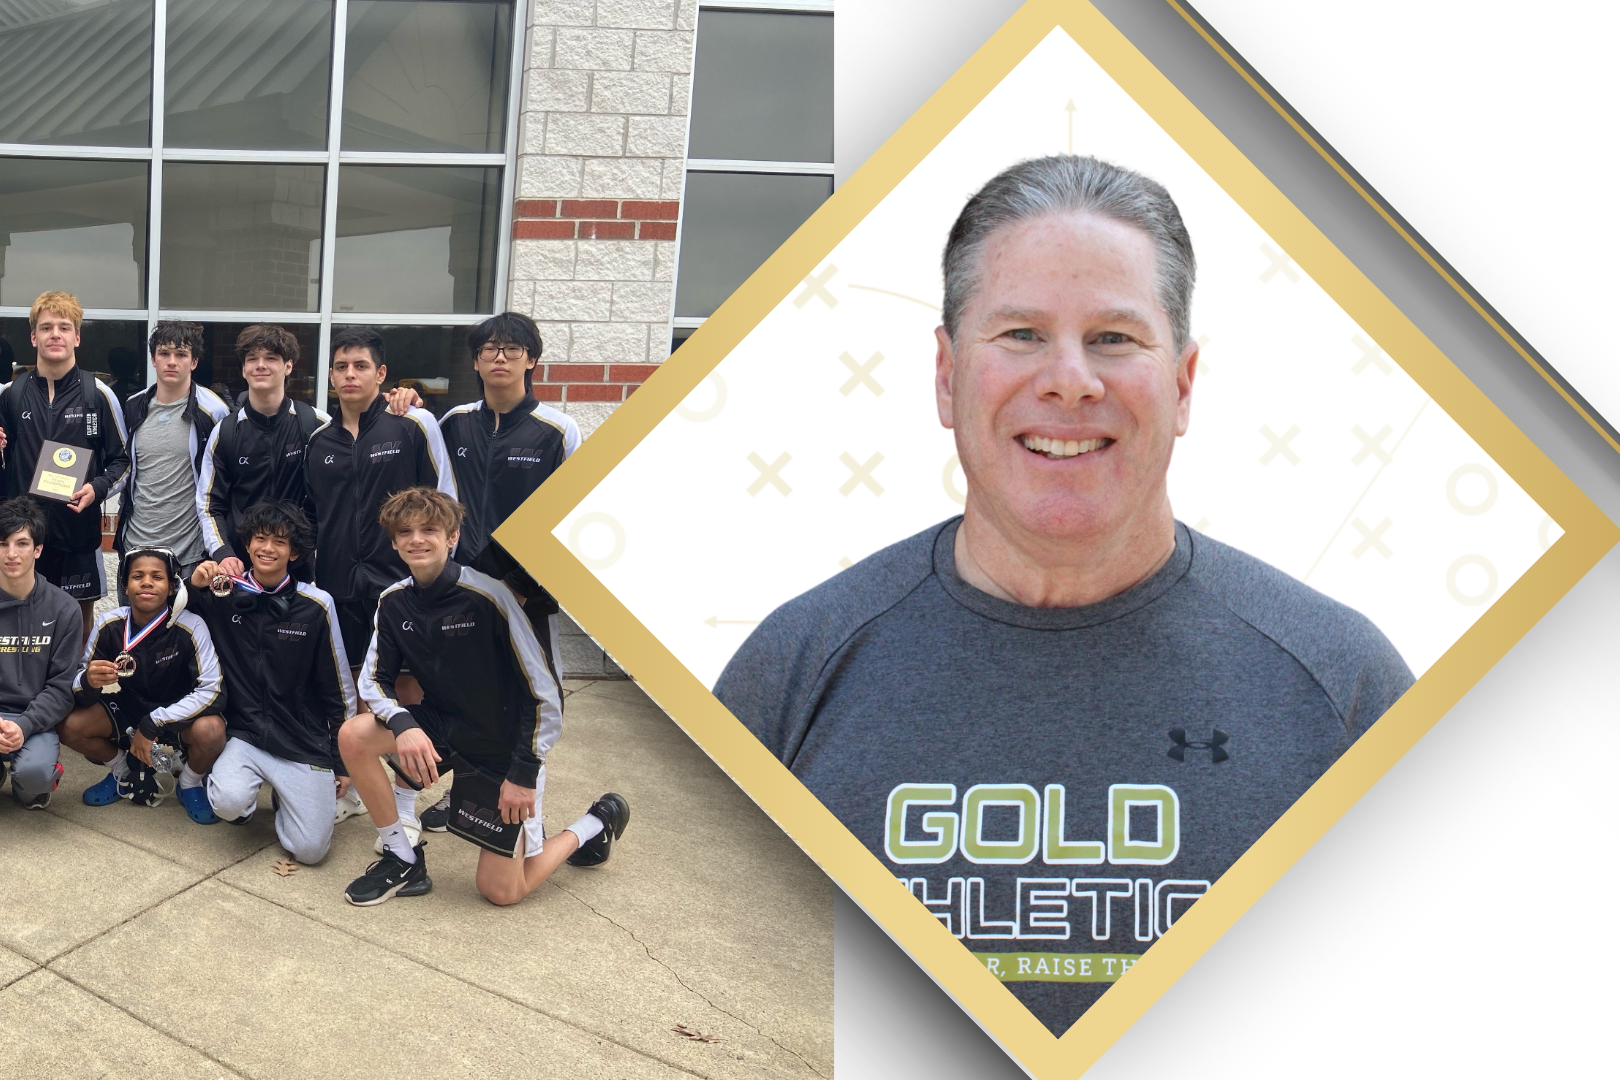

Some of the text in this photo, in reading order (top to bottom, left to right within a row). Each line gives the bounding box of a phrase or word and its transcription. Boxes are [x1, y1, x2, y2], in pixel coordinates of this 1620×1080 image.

[277, 628, 307, 637] WESTFIELD
[458, 808, 503, 833] WESTFIELD
[884, 783, 1180, 866] GOLD
[896, 877, 1212, 942] HLETIC
[1017, 957, 1092, 976] RAISE
